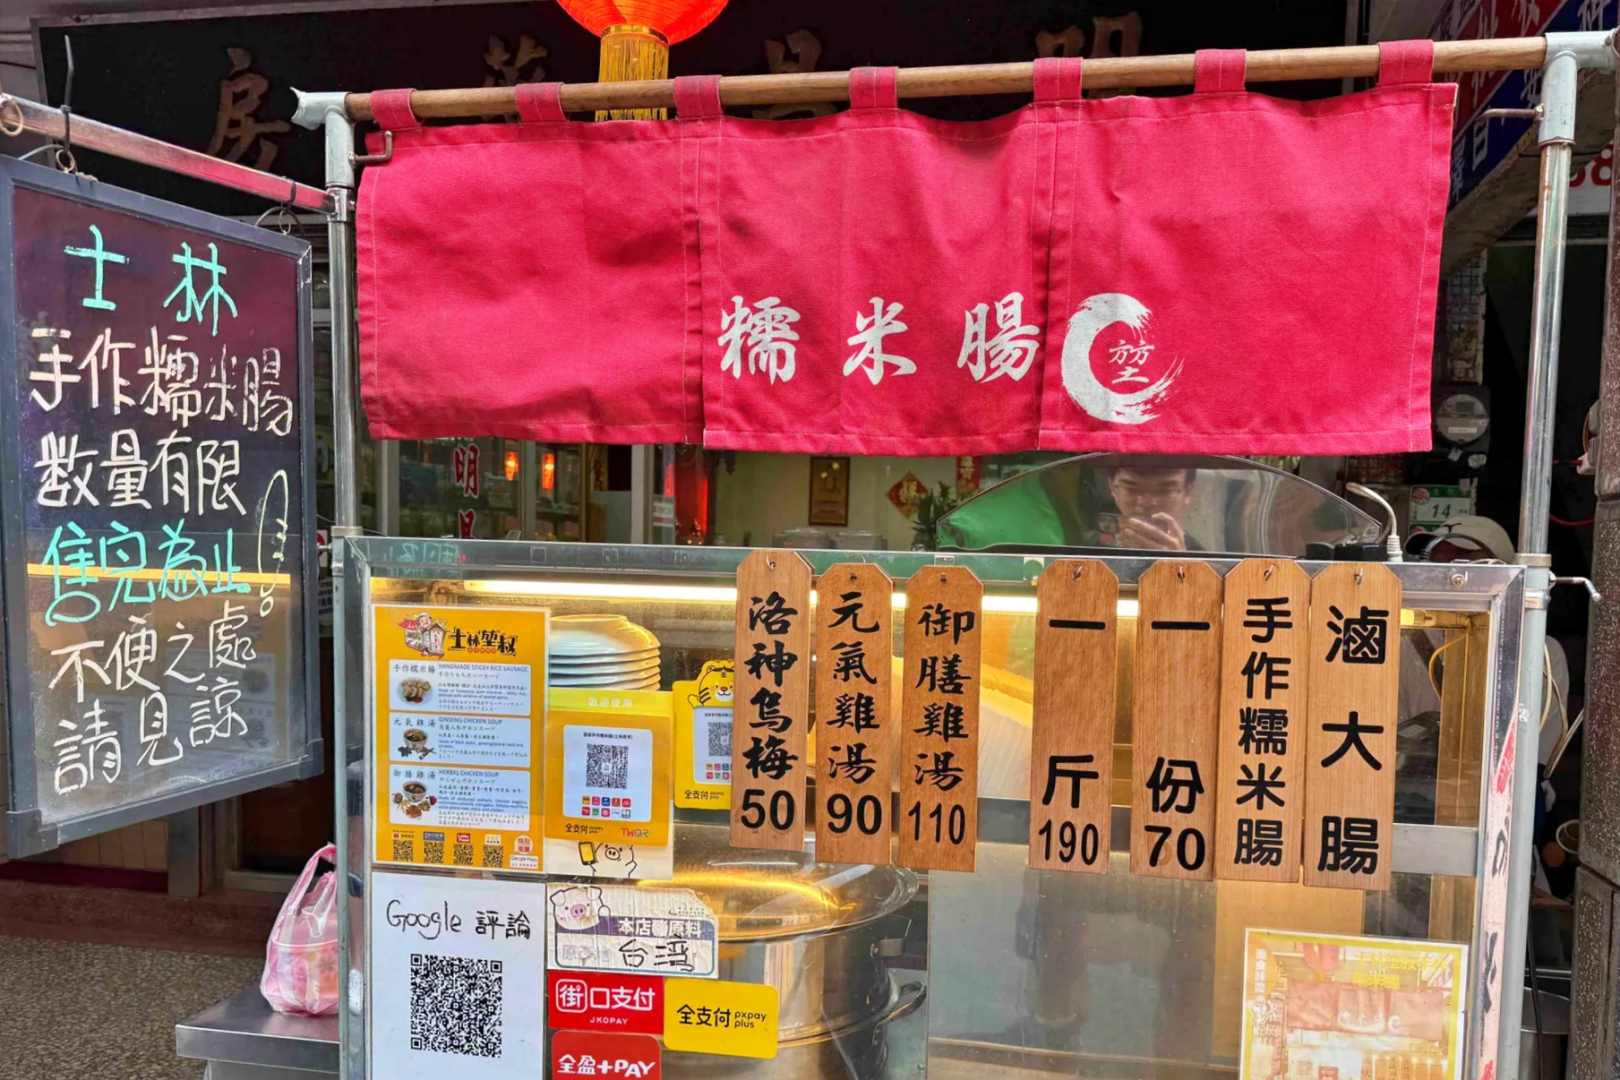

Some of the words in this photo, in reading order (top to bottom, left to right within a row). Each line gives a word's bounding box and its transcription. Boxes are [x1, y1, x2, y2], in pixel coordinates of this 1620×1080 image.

[64, 224, 239, 337] 士林
[717, 291, 1041, 386] 糯米腸
[29, 326, 295, 437] 手作糯米腸
[49, 600, 256, 703] 不便之處
[743, 590, 798, 780] 洛神烏梅
[826, 591, 881, 784] 元氣雞湯
[914, 603, 975, 791] 御膳雞湯
[1042, 619, 1106, 809] 一斤
[1146, 620, 1210, 813] 一份
[53, 676, 248, 796] 請見諒
[1234, 597, 1293, 866] 手作糯米腸
[1317, 605, 1389, 875] 滷大腸
[740, 789, 795, 831] 50
[826, 793, 882, 836] 90
[908, 801, 966, 845] 110
[1038, 819, 1099, 866] 190
[1144, 825, 1206, 871] 70
[386, 899, 462, 940] Google
[475, 909, 531, 940] 評論
[617, 918, 702, 939] 本店原料
[559, 984, 655, 1012] 街口支付
[589, 1017, 630, 1025] JKOPAY
[676, 1004, 731, 1028] 全支付
[734, 1011, 767, 1021] pxpay
[734, 1020, 755, 1029] plus
